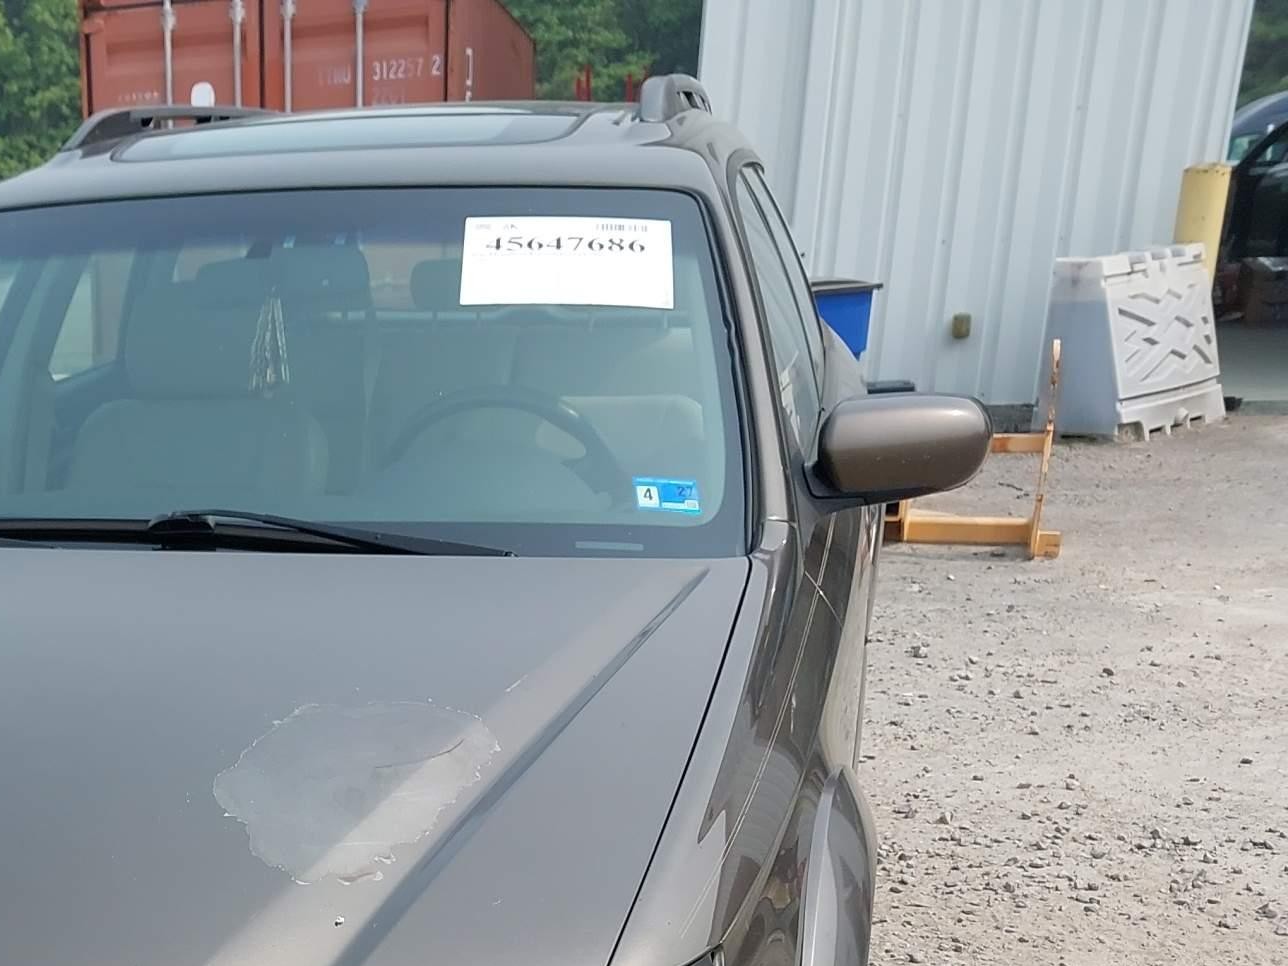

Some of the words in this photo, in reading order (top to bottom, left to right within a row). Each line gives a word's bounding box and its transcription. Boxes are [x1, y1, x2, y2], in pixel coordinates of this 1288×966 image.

[431, 54, 442, 76] 2
[485, 235, 647, 254] 45647686
[643, 487, 654, 501] 4
